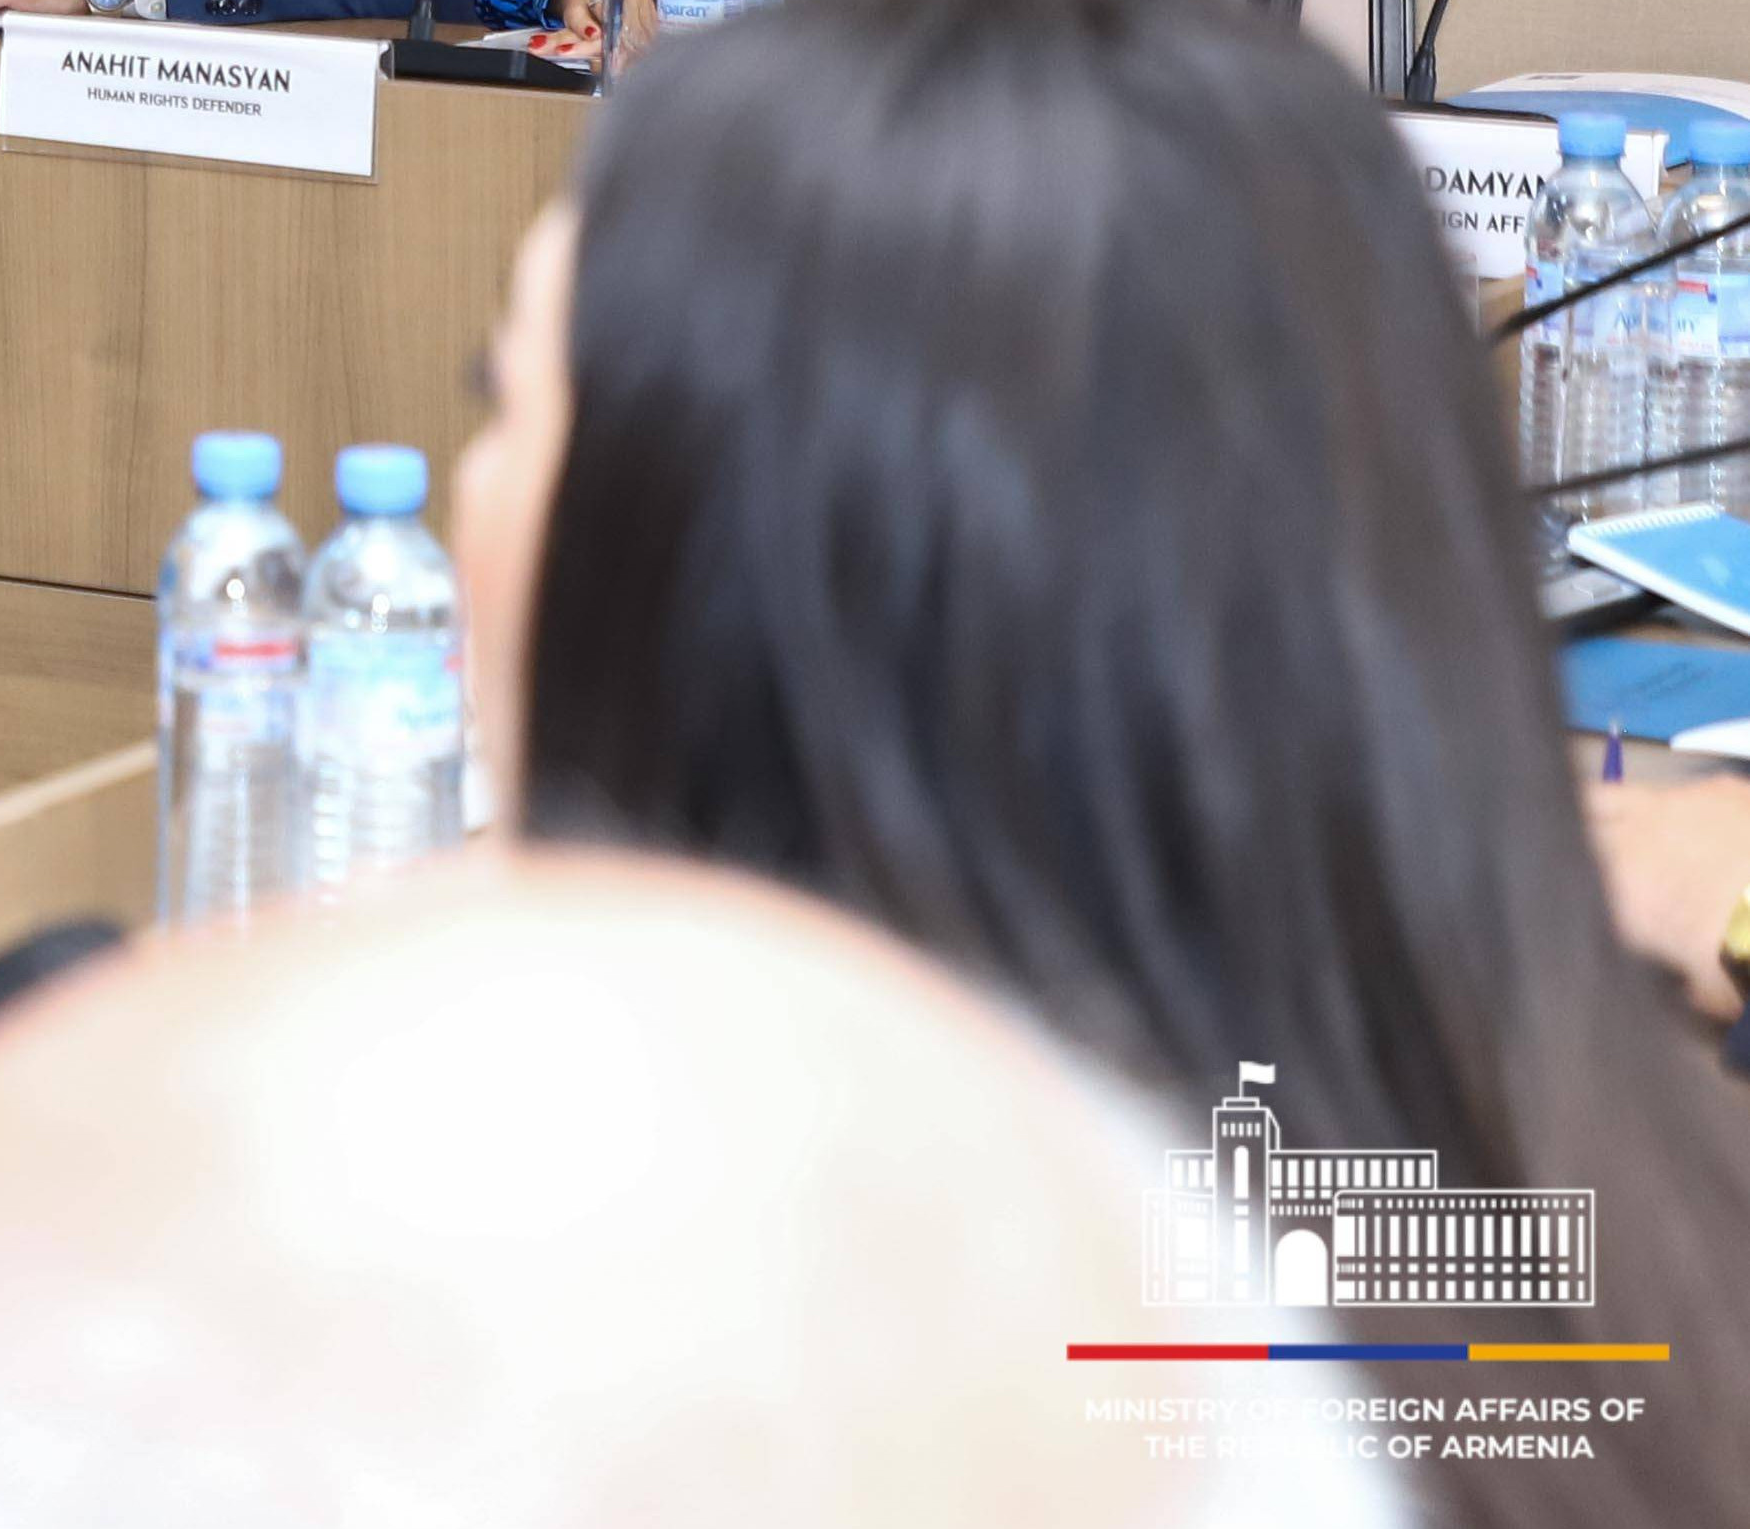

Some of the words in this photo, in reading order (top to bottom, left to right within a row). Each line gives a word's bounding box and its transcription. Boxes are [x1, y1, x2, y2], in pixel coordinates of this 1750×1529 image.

[60, 49, 152, 80] ANAHIT
[156, 58, 292, 94] MANASYAN
[87, 86, 136, 104] HUMAN
[138, 90, 190, 111] RIGHTS
[192, 97, 263, 118] DEFENDER
